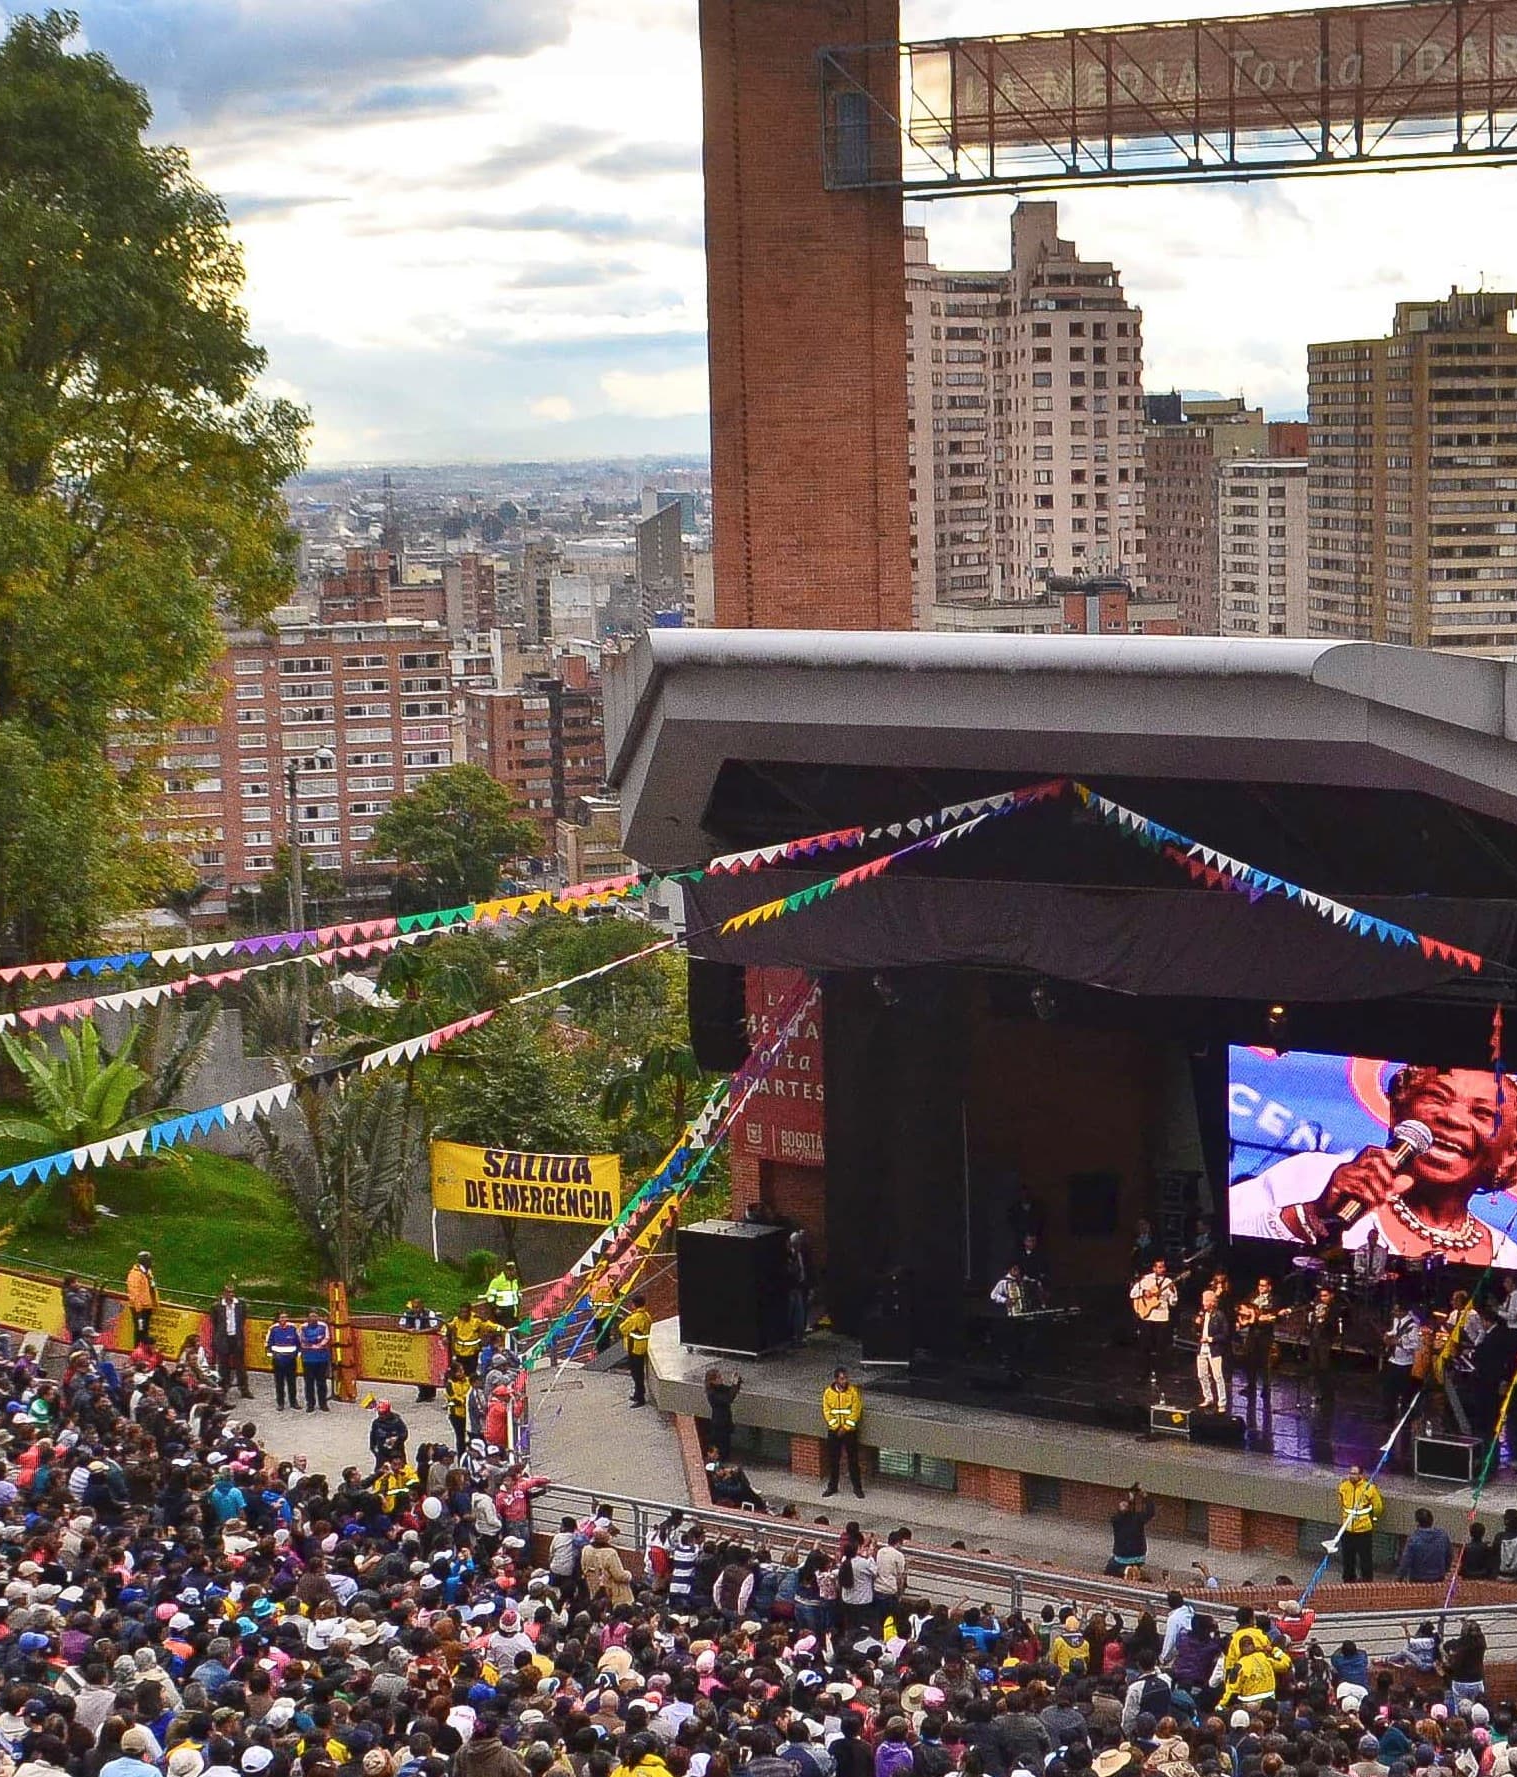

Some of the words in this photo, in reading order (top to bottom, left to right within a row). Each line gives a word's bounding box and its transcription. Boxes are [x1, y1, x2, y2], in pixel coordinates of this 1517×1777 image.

[1231, 47, 1362, 91] Torta
[483, 1150, 592, 1185] SALIDA
[464, 1179, 489, 1209] DE
[491, 1181, 613, 1221] EMERGENCIA
